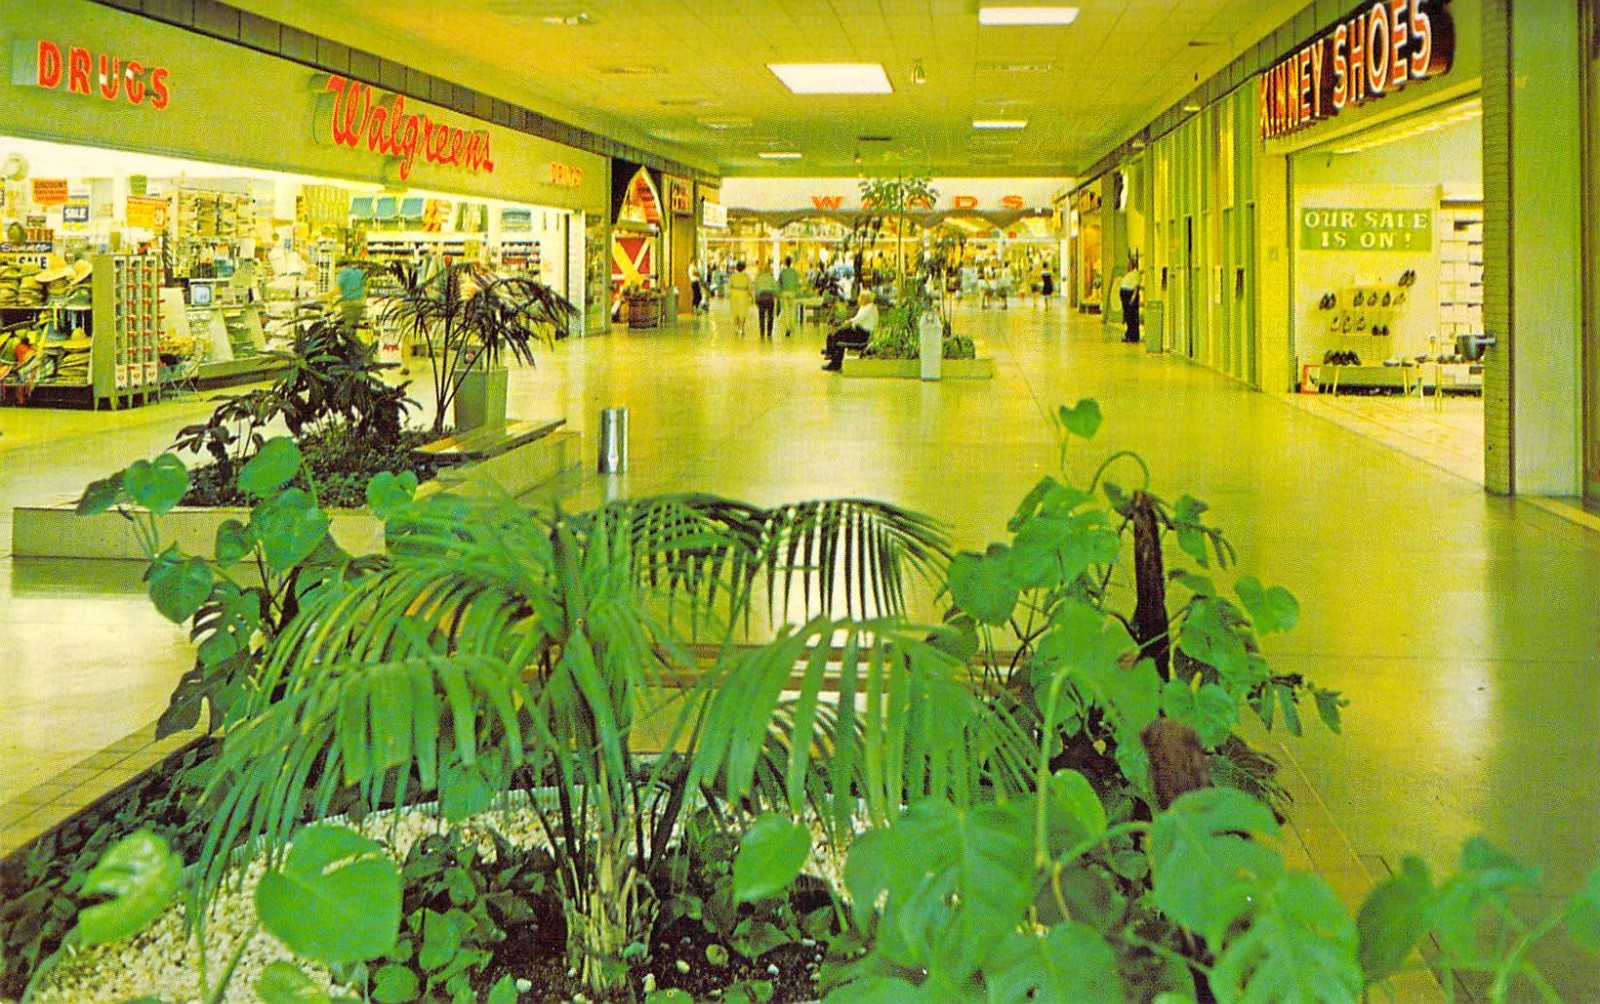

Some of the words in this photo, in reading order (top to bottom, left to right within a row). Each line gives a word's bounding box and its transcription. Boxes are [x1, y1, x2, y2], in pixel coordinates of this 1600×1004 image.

[37, 40, 171, 110] DRUGS
[1260, 38, 1323, 139] KINNEY
[1333, 0, 1431, 109] SHOES
[325, 74, 495, 181] Walgreens
[811, 195, 1024, 210] WDS
[64, 208, 87, 219] SALE
[1304, 211, 1356, 228] OUR
[1364, 211, 1427, 229] SALE
[1321, 232, 1346, 248] IS
